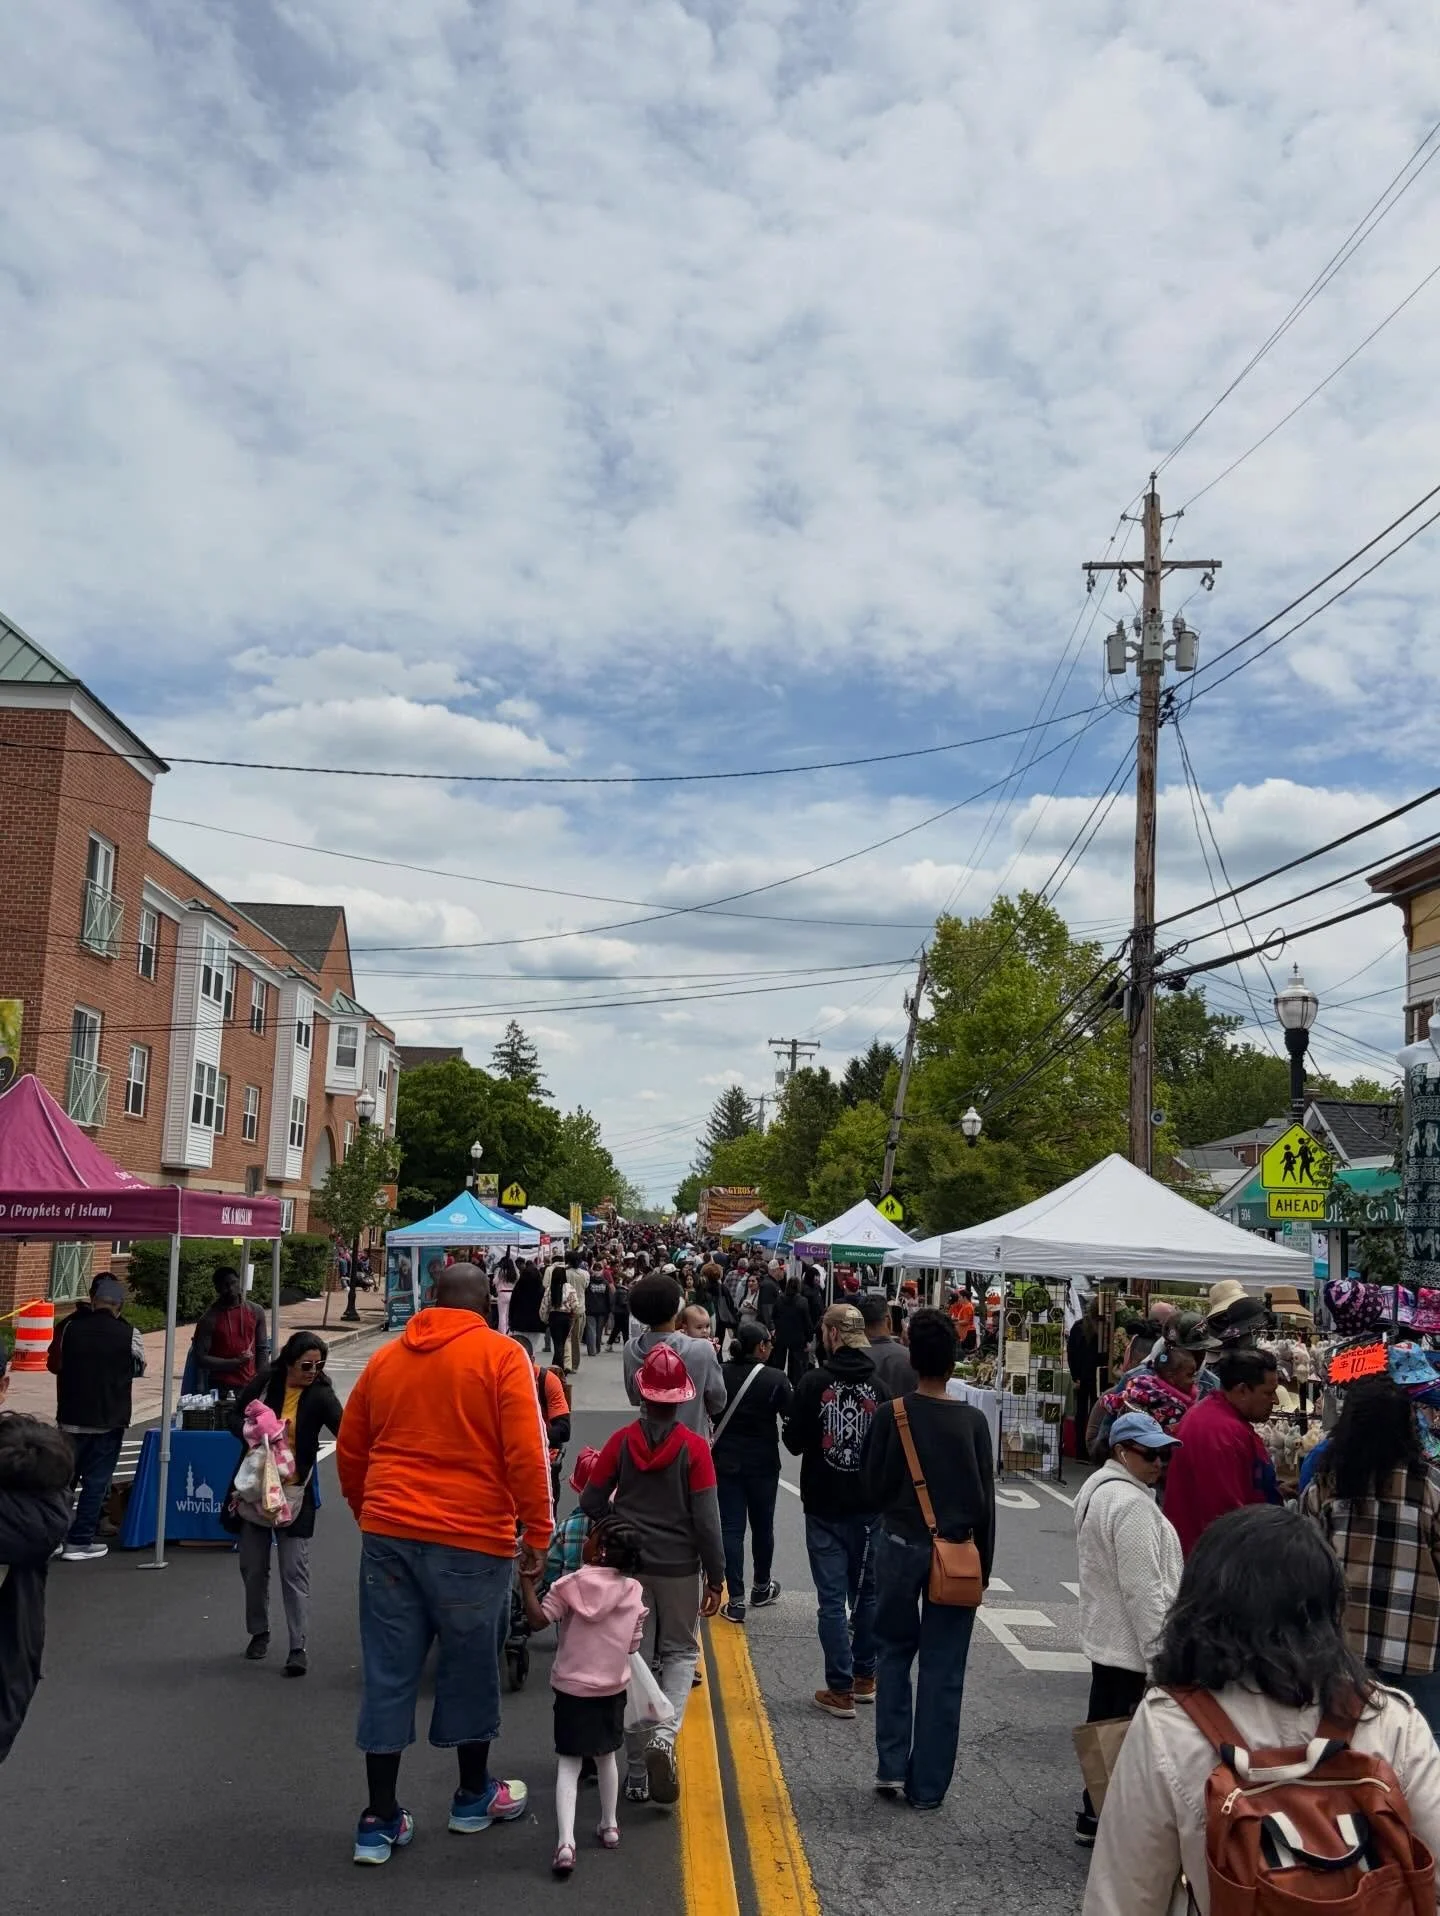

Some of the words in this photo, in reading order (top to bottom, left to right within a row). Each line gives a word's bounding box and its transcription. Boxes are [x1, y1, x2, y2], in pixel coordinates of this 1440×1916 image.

[728, 1186, 751, 1195] GYROS
[10, 1203, 61, 1220] (Prophets
[64, 1203, 76, 1220] of
[79, 1203, 112, 1219] Islam)
[1276, 1200, 1319, 1213] AHEAD
[221, 1206, 231, 1224] ASK
[1284, 1222, 1292, 1234] 2
[1341, 1349, 1378, 1360] SPECIAL
